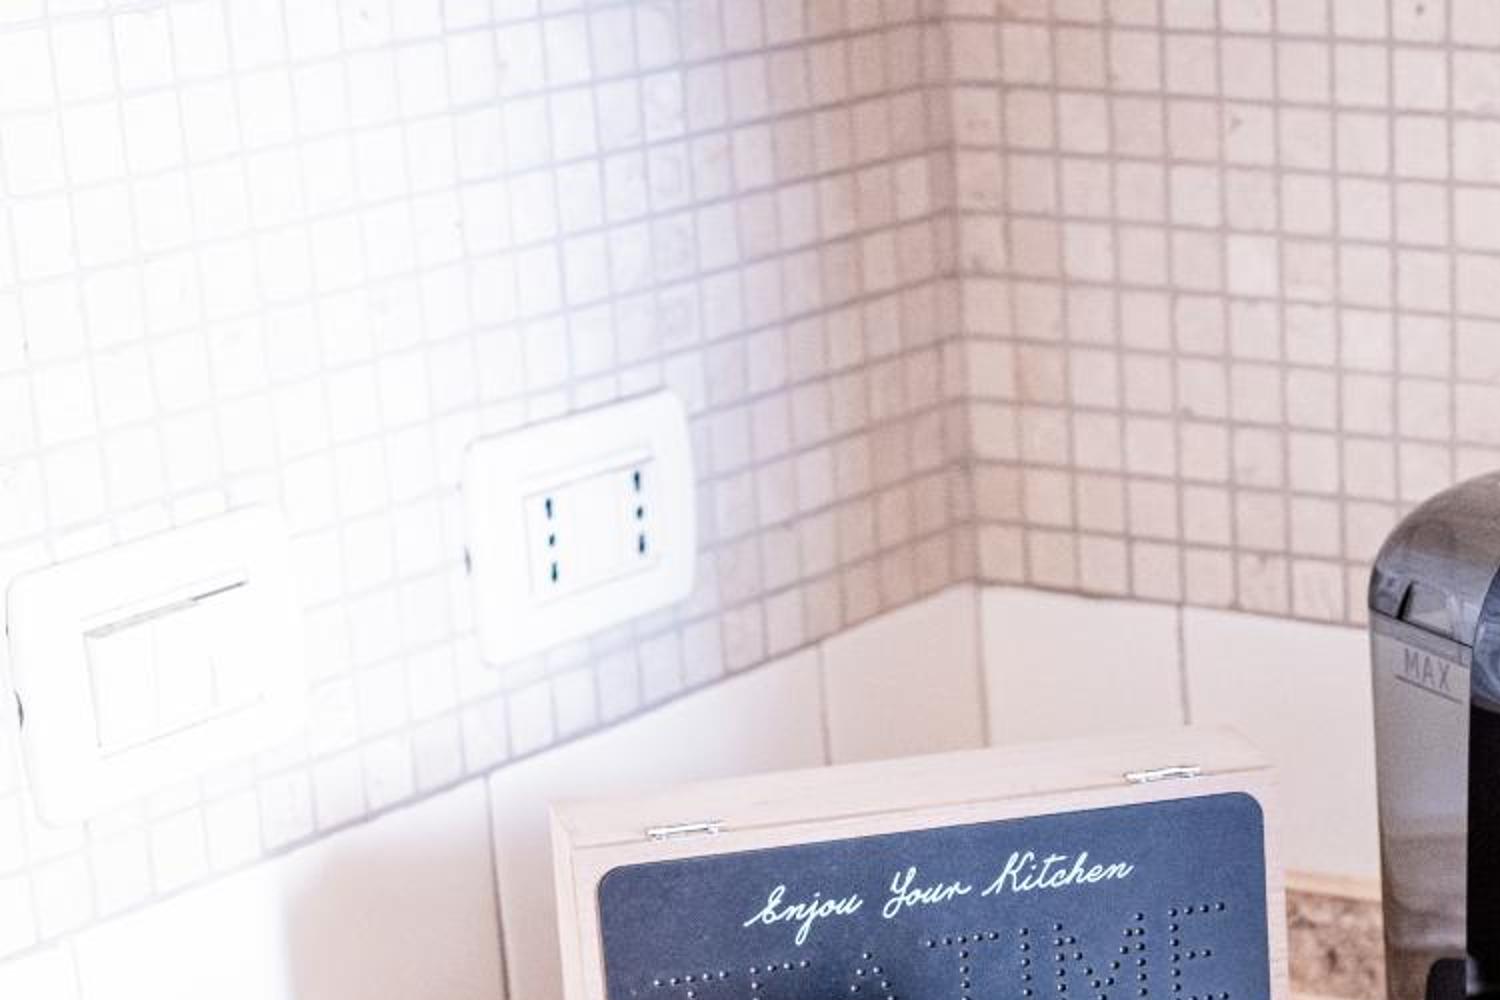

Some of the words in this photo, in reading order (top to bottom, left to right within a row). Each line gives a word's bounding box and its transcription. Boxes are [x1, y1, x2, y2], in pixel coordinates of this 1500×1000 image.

[1404, 647, 1451, 692] MAX
[883, 866, 972, 919] Your
[981, 851, 1135, 897] Kitchen
